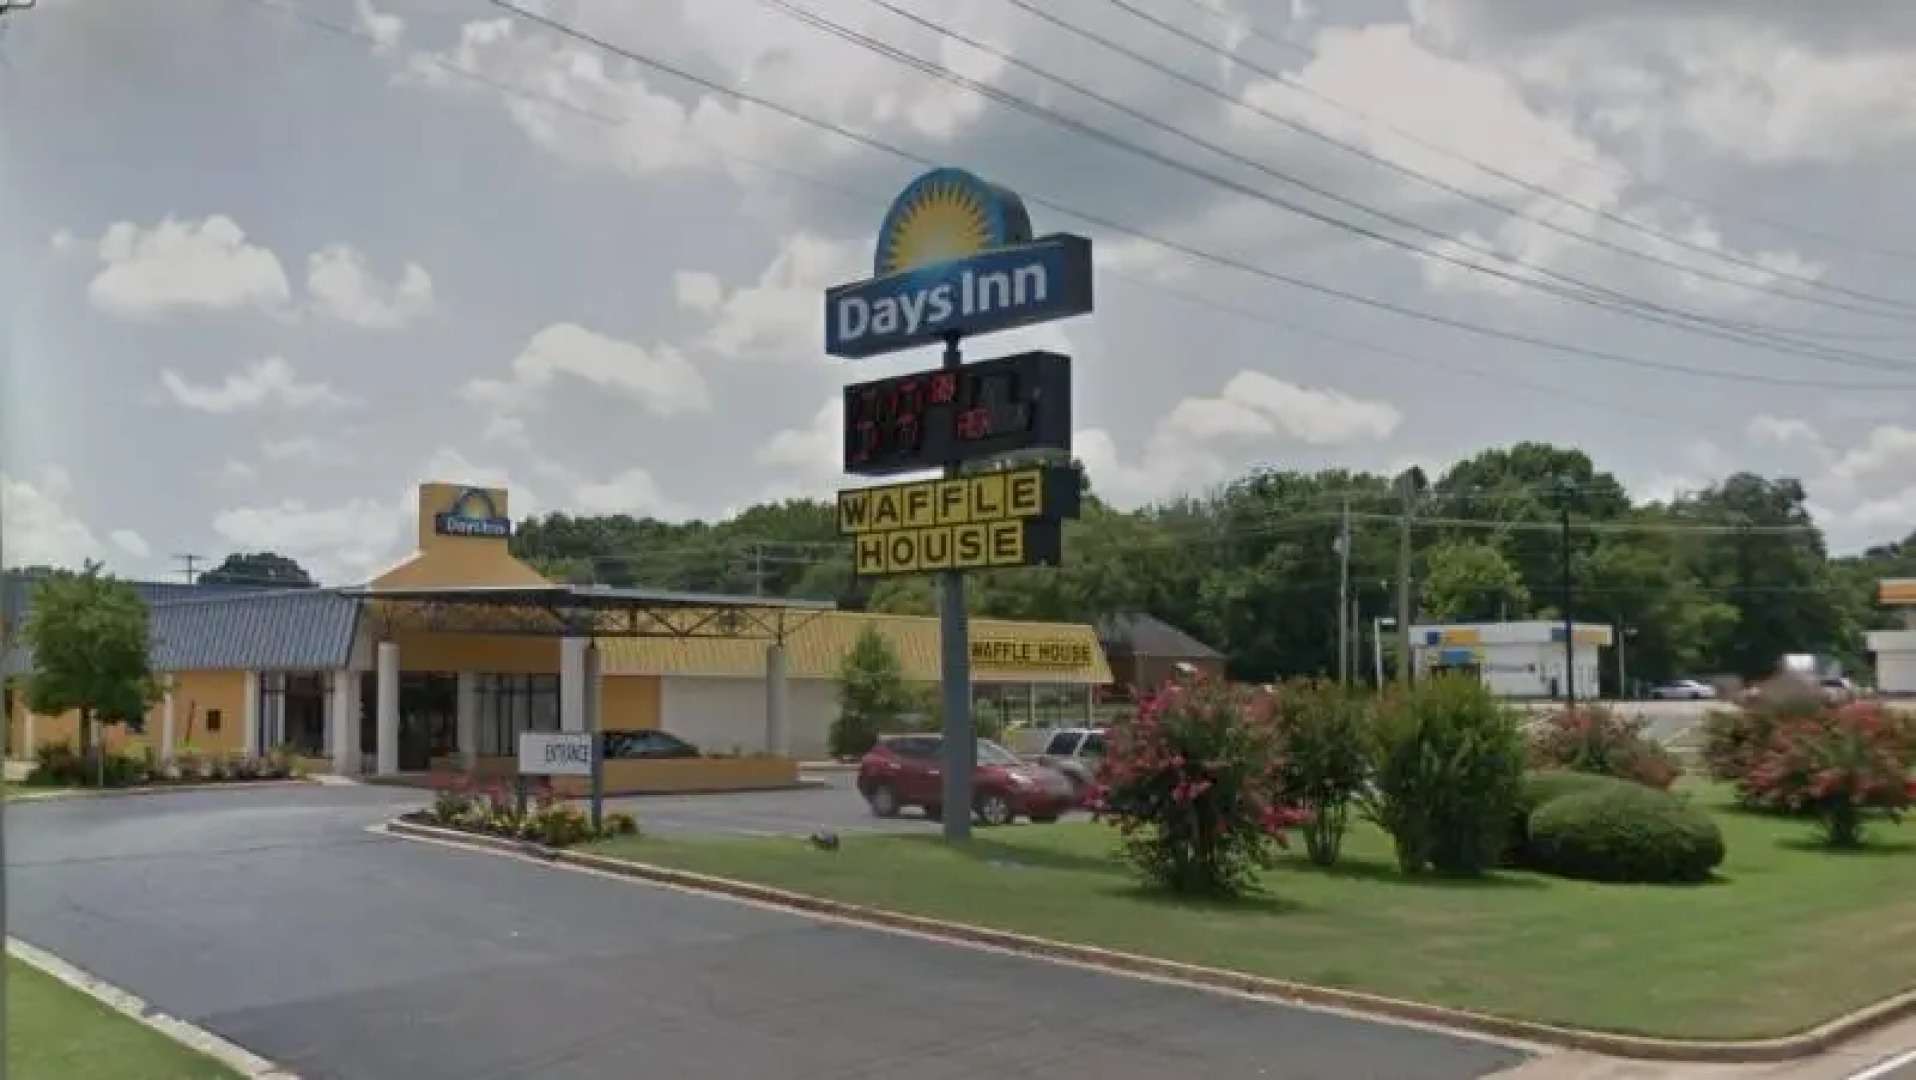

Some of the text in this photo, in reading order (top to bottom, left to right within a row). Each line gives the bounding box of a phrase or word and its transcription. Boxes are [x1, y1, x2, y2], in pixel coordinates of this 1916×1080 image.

[838, 263, 1048, 341] Days Inn
[842, 478, 1036, 526] WAFFLE
[860, 526, 1018, 568] HOUSE
[971, 641, 1092, 662] WAFFLE HOUSE
[545, 744, 590, 762] ENTRANCE
